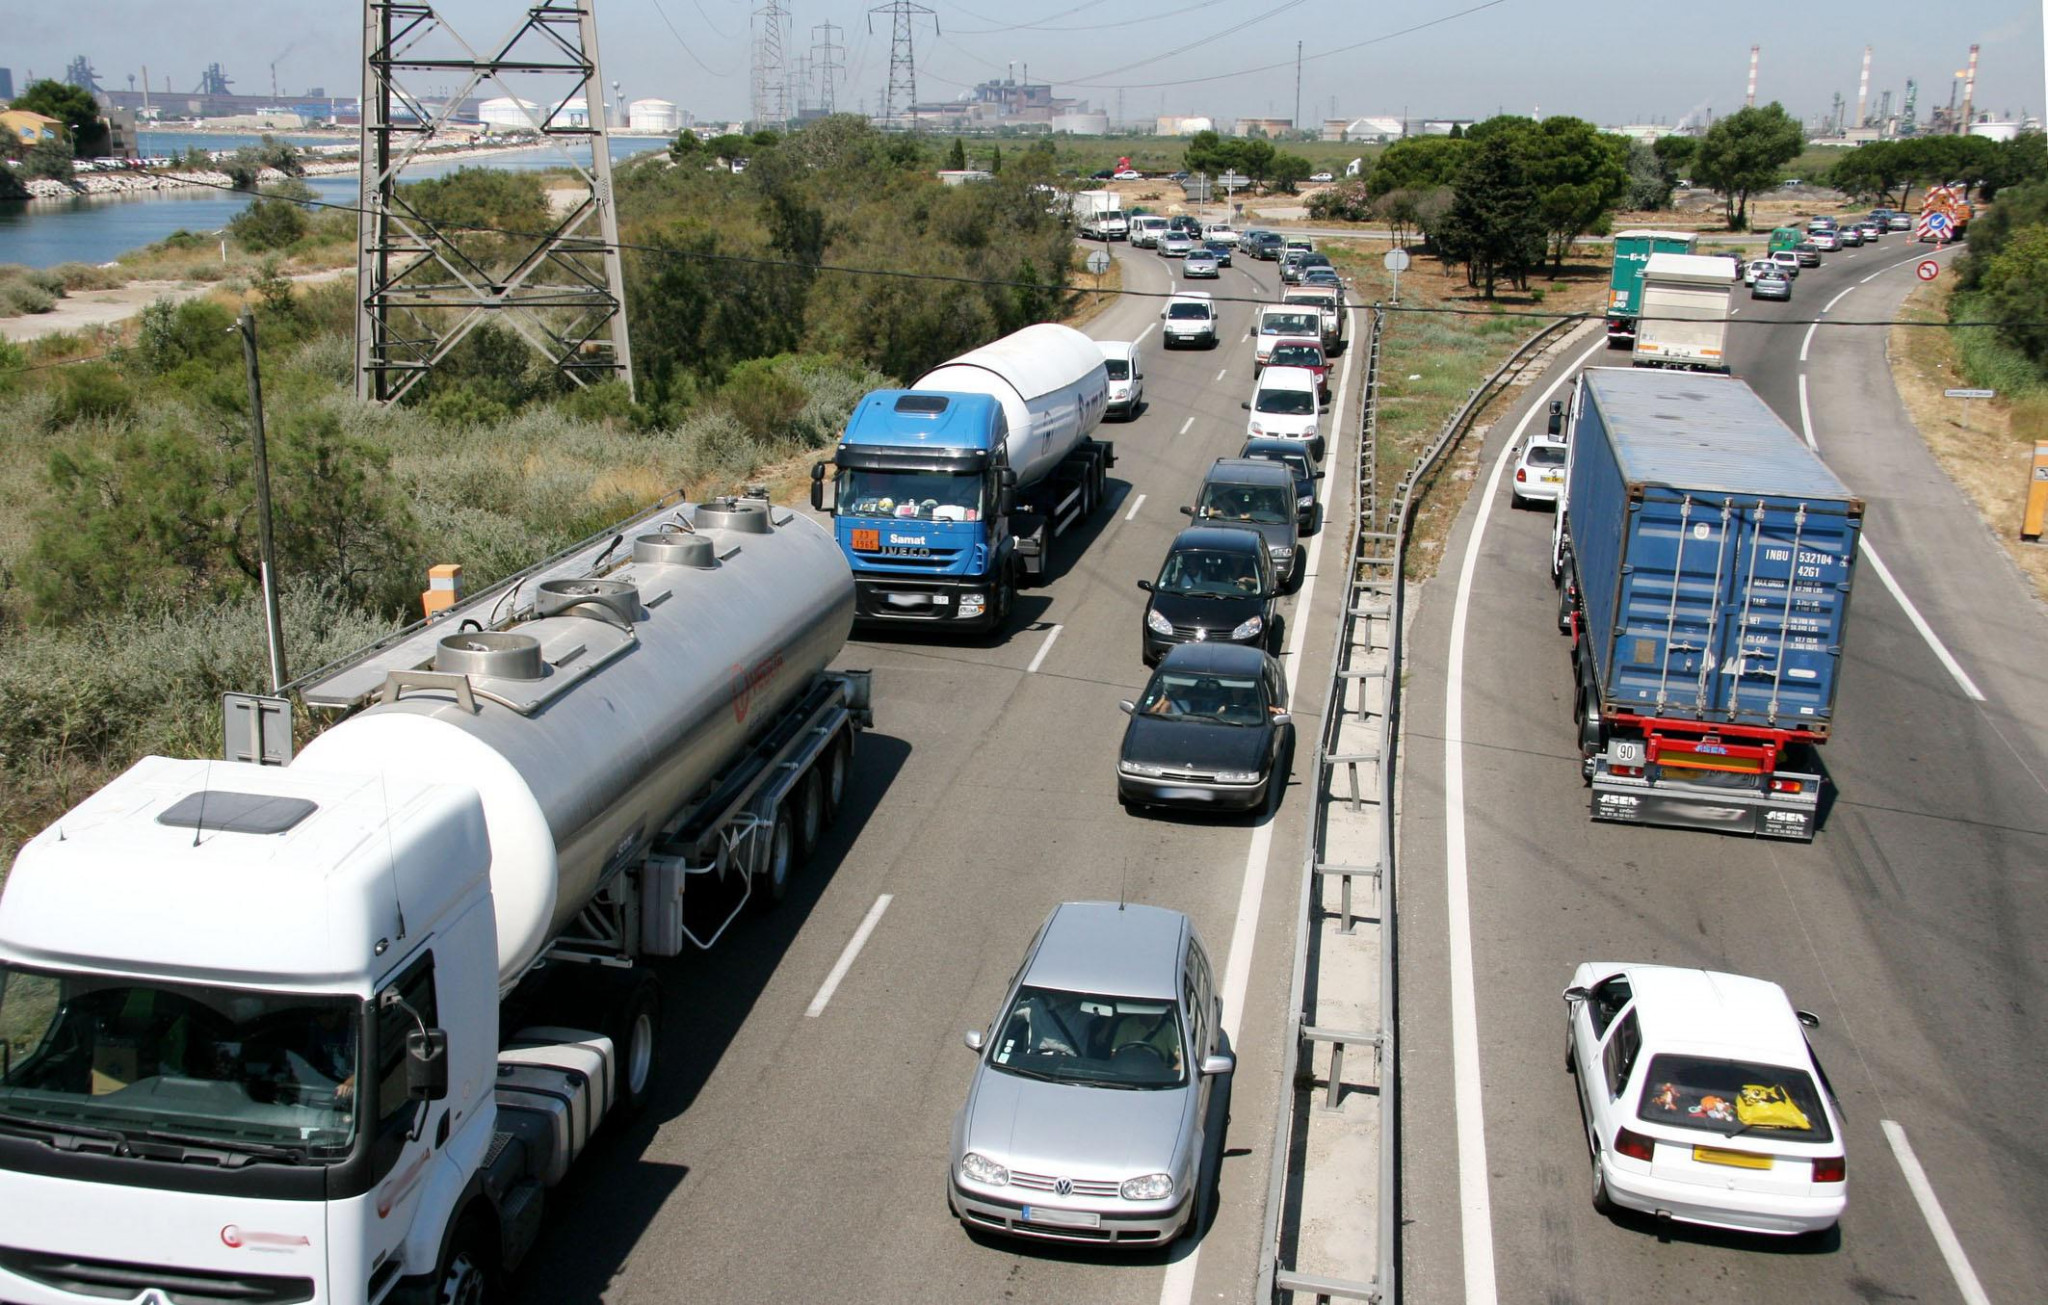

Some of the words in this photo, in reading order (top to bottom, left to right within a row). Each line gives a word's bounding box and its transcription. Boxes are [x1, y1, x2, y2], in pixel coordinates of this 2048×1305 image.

[890, 533, 926, 545] Samat
[881, 546, 931, 558] IVECO
[1765, 549, 1789, 561] INBU
[1798, 551, 1832, 565] 532104
[1797, 566, 1820, 577] 42G1
[1620, 745, 1633, 759] 90
